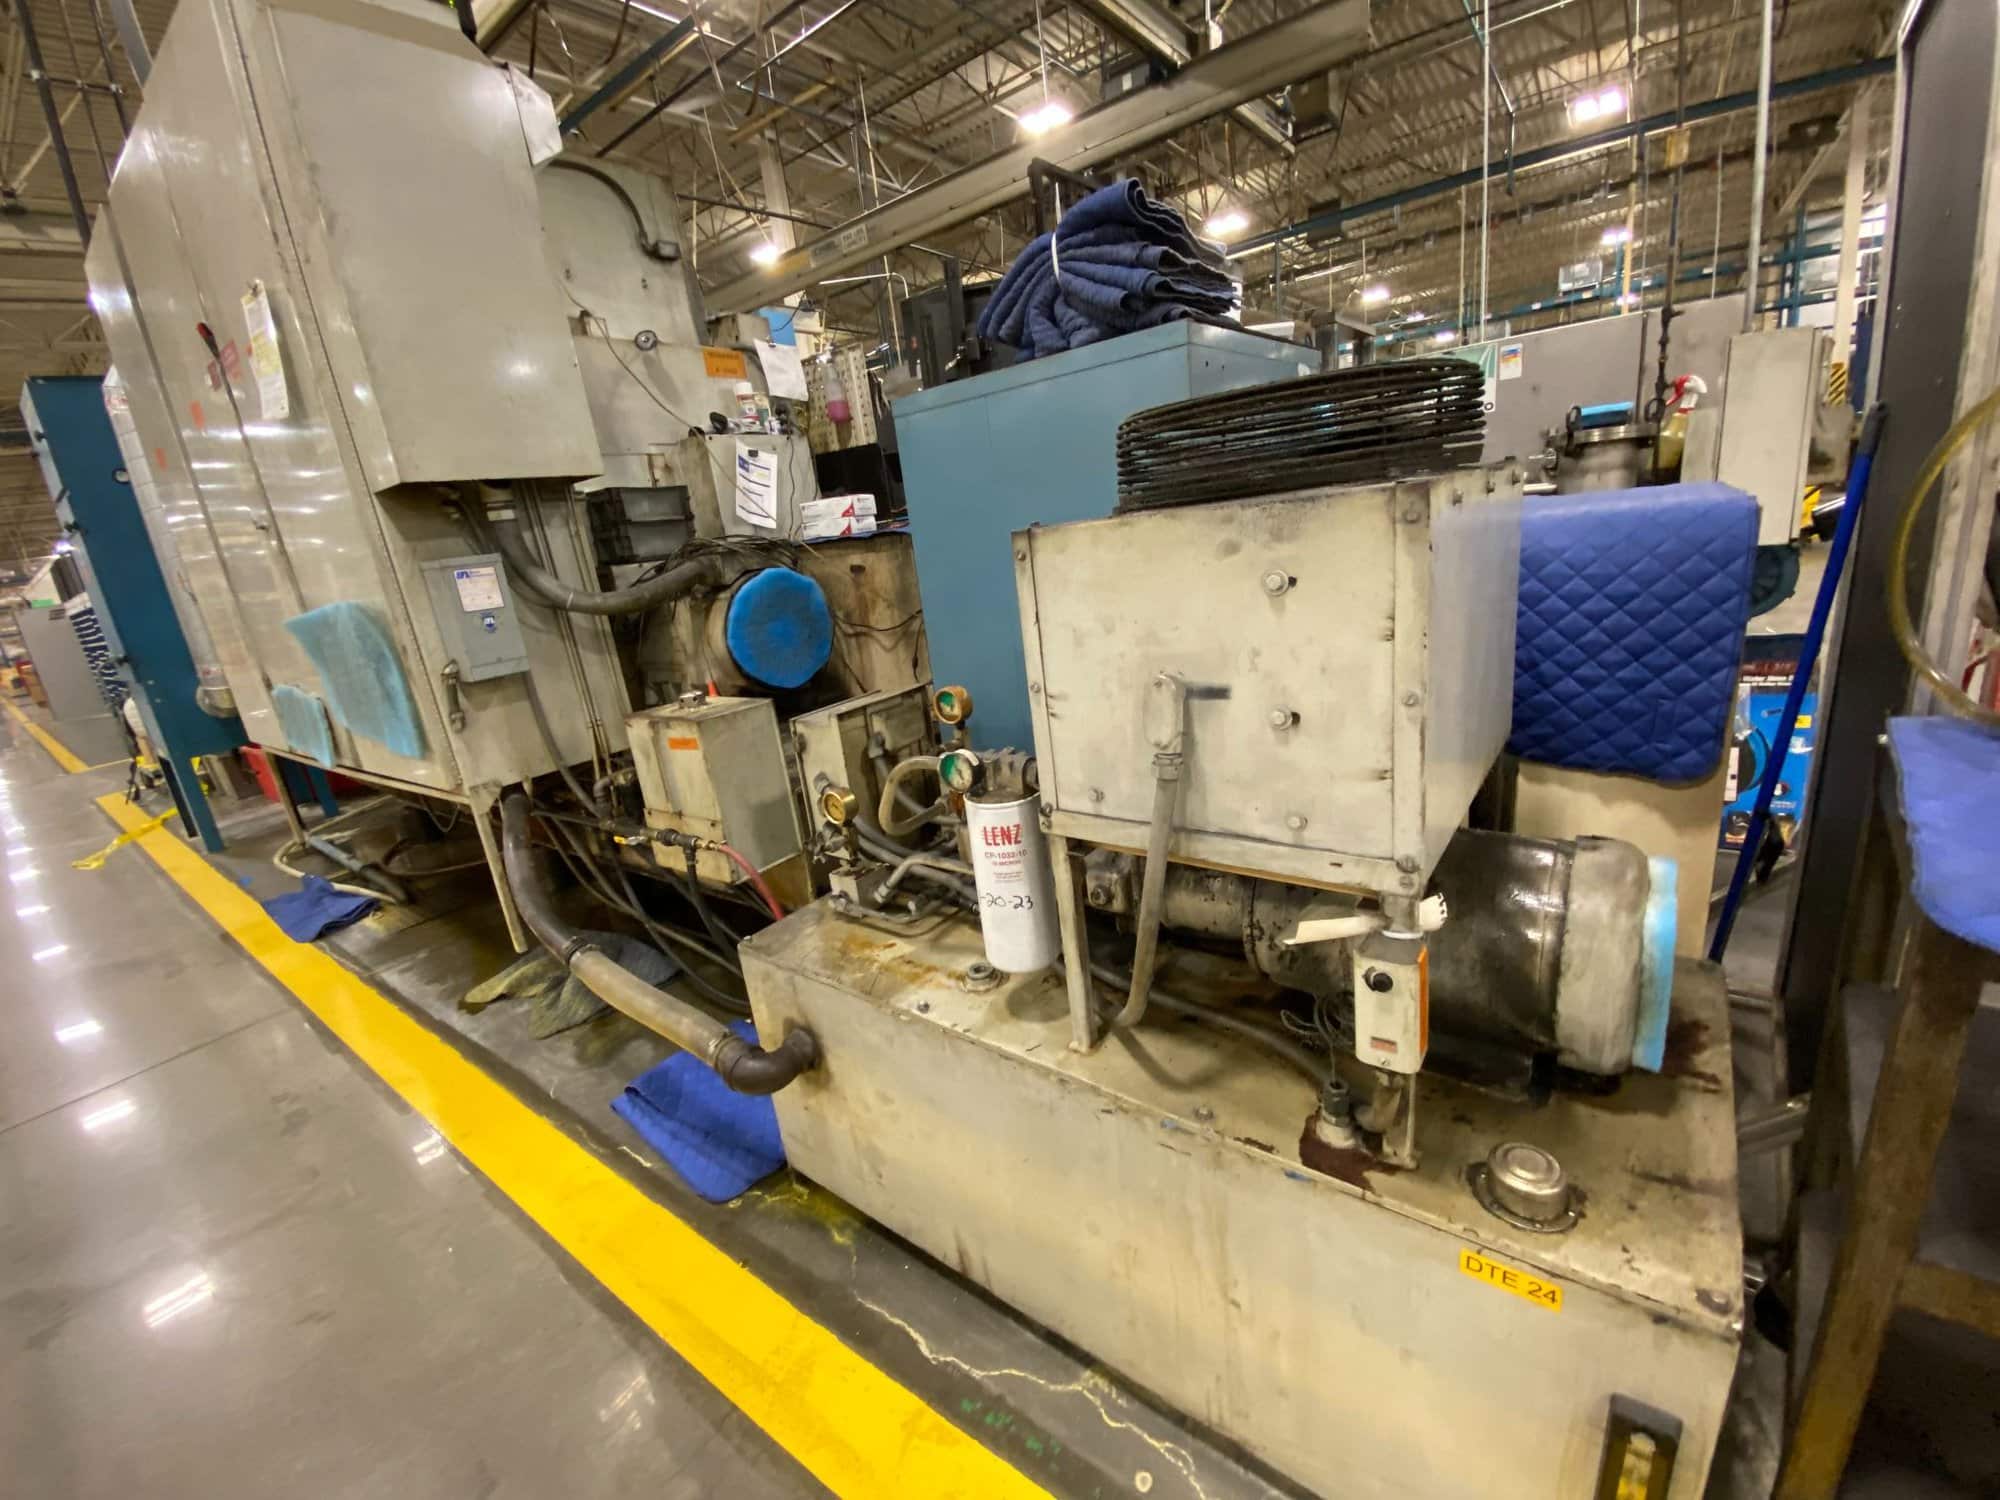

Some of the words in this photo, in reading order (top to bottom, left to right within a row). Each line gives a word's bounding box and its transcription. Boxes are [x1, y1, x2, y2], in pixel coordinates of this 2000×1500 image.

[983, 824, 1022, 847] LENZ
[1466, 1255, 1519, 1289] DTE
[1527, 1281, 1558, 1304] 24
